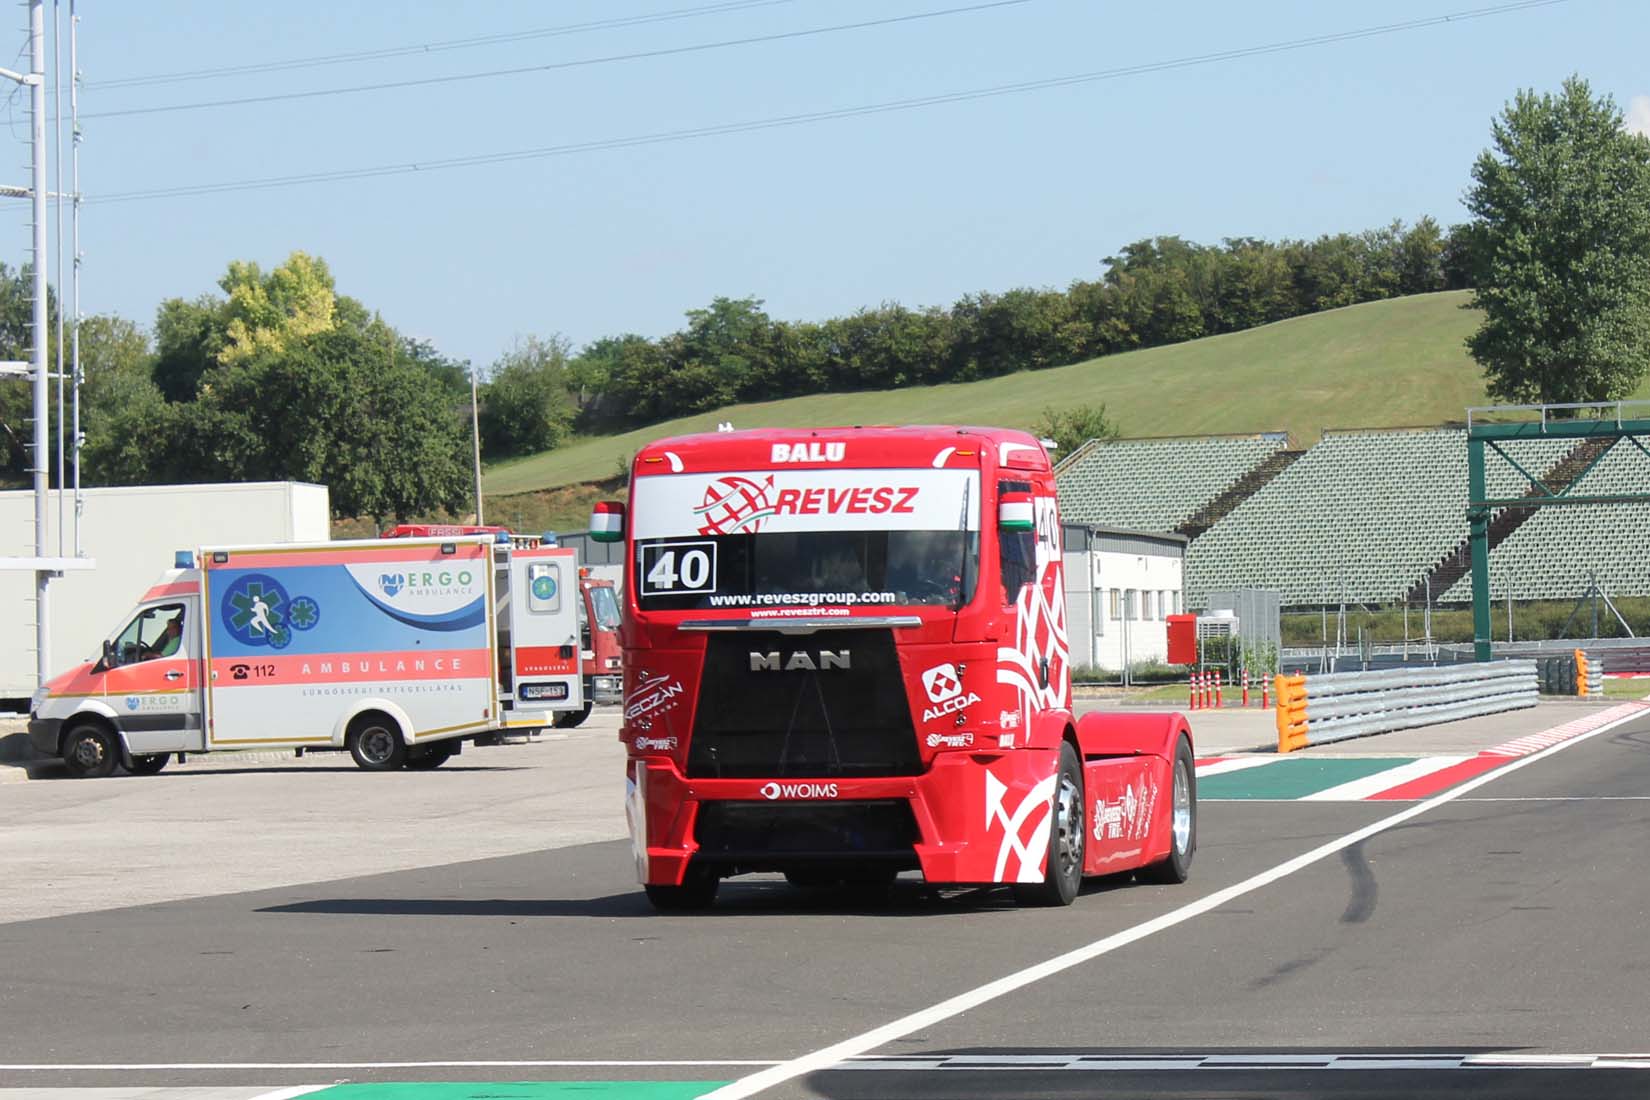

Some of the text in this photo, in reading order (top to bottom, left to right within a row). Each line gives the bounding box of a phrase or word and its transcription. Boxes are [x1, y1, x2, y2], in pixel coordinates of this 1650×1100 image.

[770, 442, 846, 463] BALU
[1038, 508, 1058, 550] 40
[647, 549, 710, 589] 40
[409, 586, 473, 596] AMBULANCE
[710, 591, 896, 607] www.reveszgroup.com
[751, 607, 850, 618] www.revesztrt.com
[302, 658, 462, 675] AMBULANCE
[750, 650, 850, 671] MAN
[253, 664, 276, 677] 112
[923, 692, 982, 723] ALCOA
[781, 784, 838, 797] WOIMS
